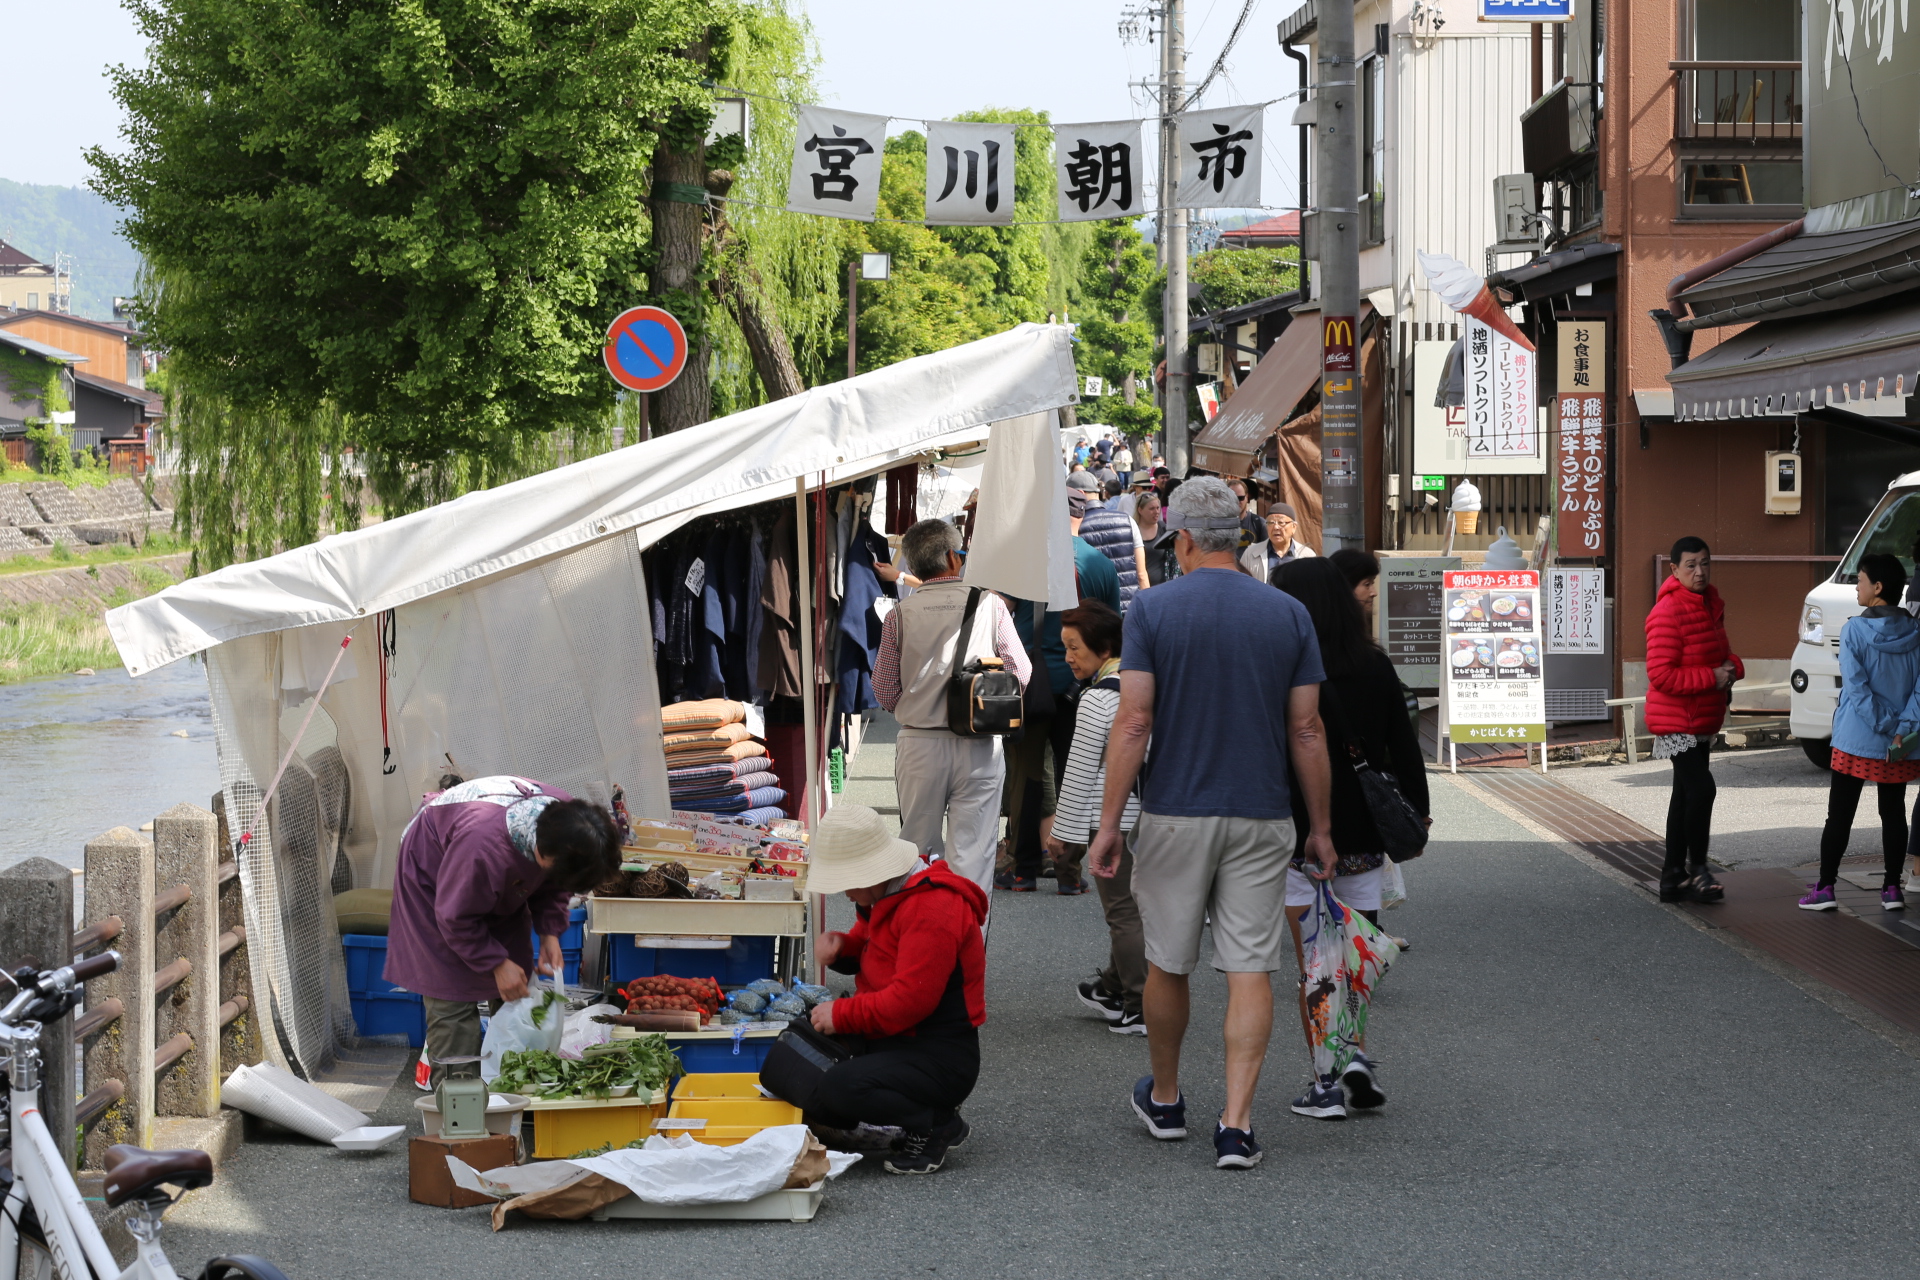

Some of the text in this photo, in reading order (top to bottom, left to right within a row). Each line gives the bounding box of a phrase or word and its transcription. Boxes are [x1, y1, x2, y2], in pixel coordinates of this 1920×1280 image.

[1573, 328, 1590, 387] お食事処
[1472, 327, 1489, 452] 地酒ソフトクリーム
[1500, 341, 1514, 451] コーヒーソフトクリーム
[1514, 354, 1529, 451] 桃ソフトクリーム
[1561, 397, 1581, 512] 飛騨牛うどん
[1583, 397, 1602, 550] 飛騨牛のどんぶり
[1452, 574, 1533, 587] 朝6時から営業
[1554, 574, 1563, 638] 地酒ソフトクリーム
[1569, 574, 1579, 638] 桃ソフトクリーム
[1592, 574, 1600, 603] コーヒー
[1584, 588, 1592, 638] ソフトクリーム
[1507, 682, 1529, 690] 600円
[1507, 690, 1529, 698] 600円
[1469, 726, 1528, 738] かじばし食堂
